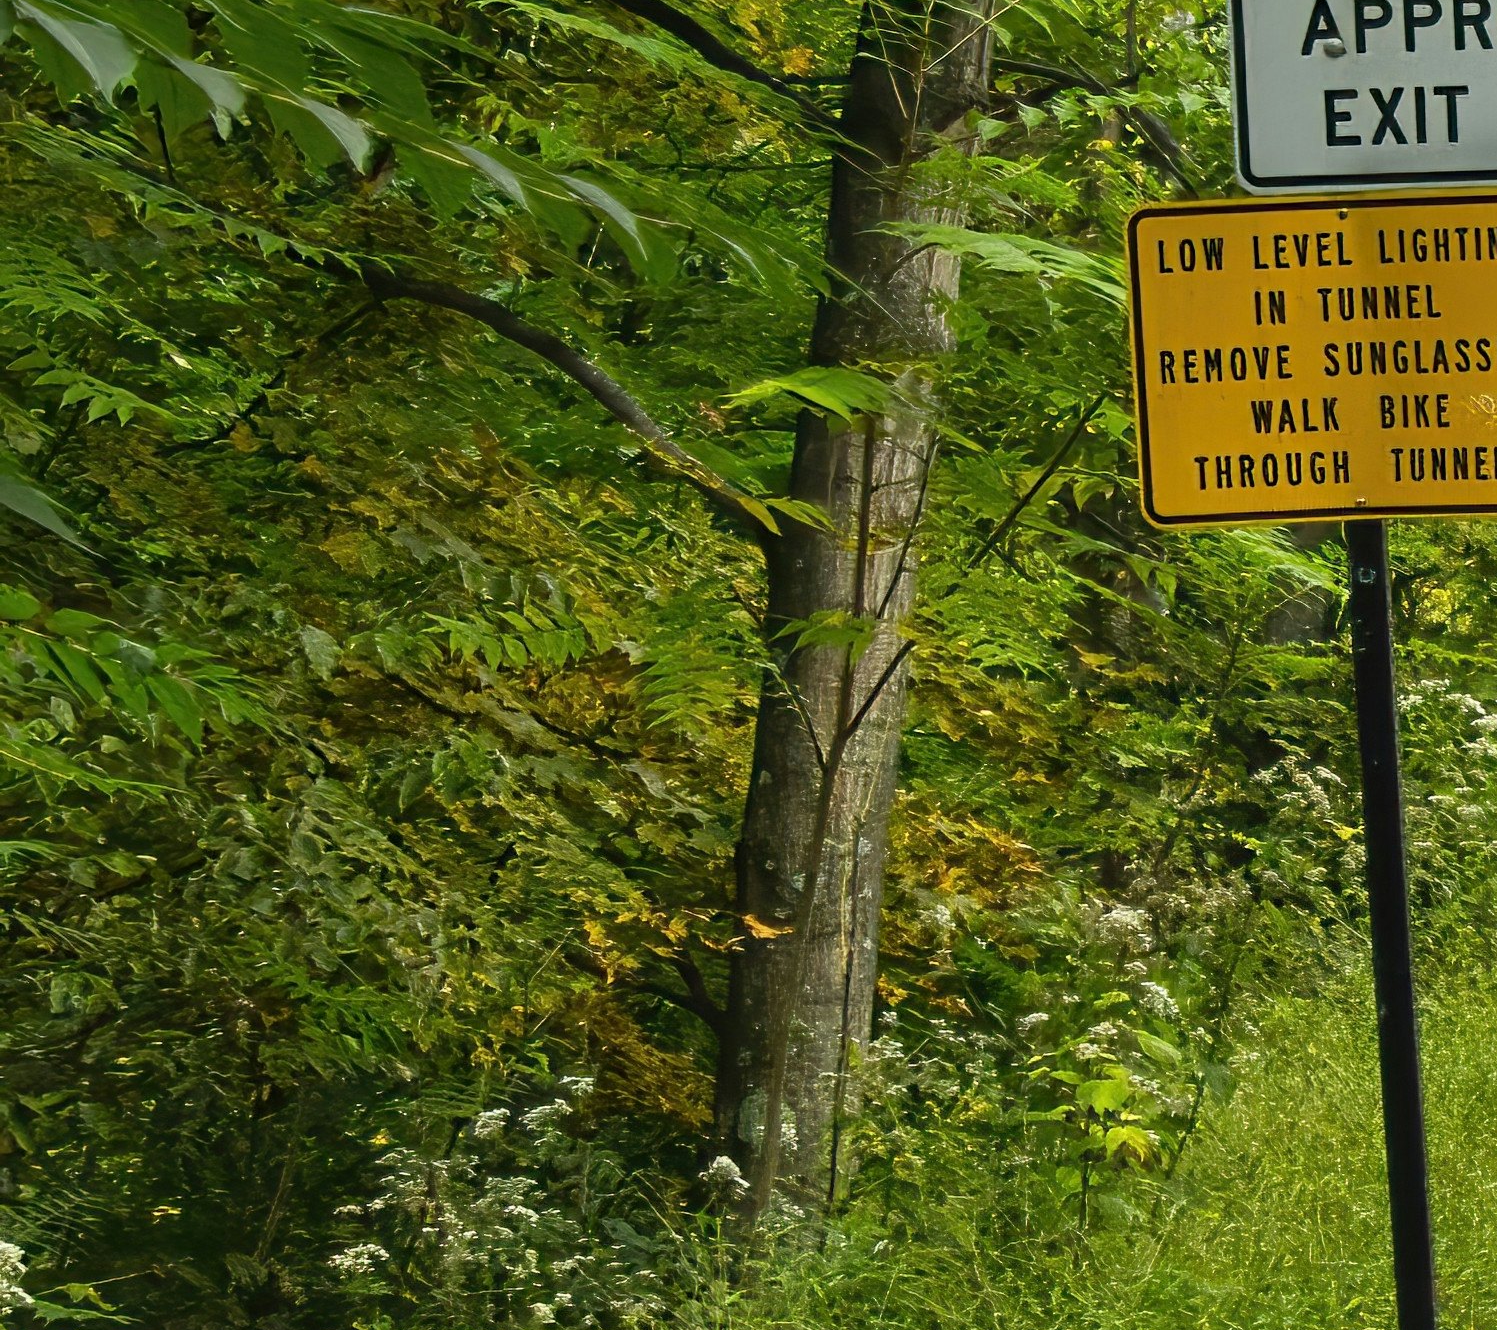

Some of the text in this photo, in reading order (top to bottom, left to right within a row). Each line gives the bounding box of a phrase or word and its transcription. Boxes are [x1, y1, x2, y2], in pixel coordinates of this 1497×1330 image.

[1324, 85, 1468, 146] EXIT
[1158, 238, 1223, 273] LOW
[1253, 232, 1352, 269] LEVEL
[1255, 285, 1441, 325] IN TUNNEL
[1160, 345, 1292, 384] REMOVE
[1251, 394, 1449, 433] WALK BIKE
[1194, 451, 1349, 490] THROUGH
